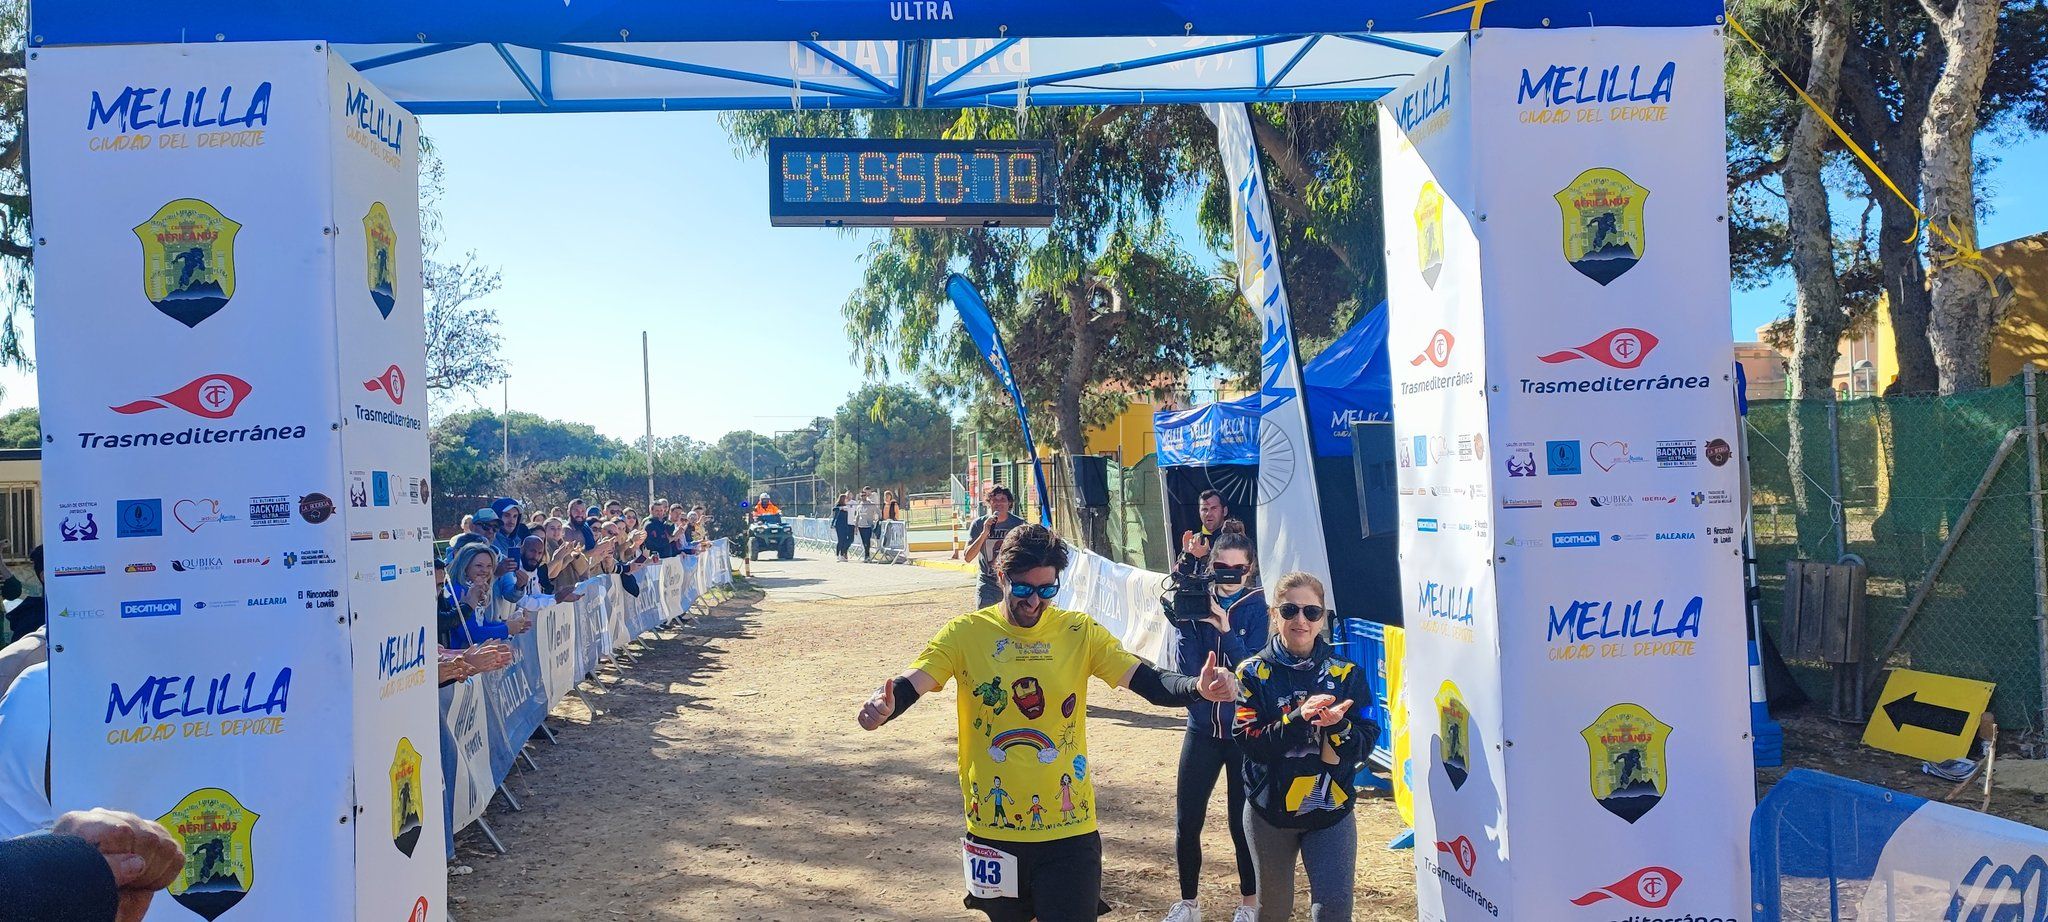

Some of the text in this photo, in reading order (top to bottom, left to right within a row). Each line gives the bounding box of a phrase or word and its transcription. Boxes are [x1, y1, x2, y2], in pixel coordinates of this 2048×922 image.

[890, 1, 953, 21] ULTRA
[1517, 61, 1676, 108] MELILLA
[87, 82, 272, 133] MELILLA
[1396, 65, 1451, 138] MELILLA
[346, 82, 402, 157] MELILLA
[1519, 105, 1670, 124] CIUDAD DEL DEPORTE
[89, 130, 266, 152] CIUDAD DEL DEPORTE
[1520, 375, 1710, 394] Trasmediterránea
[354, 404, 421, 430] Trasmediterránea
[78, 424, 306, 449] Trasmediterránea
[1656, 447, 1696, 456] BACKYARD
[250, 504, 290, 514] BACKYARD
[1599, 495, 1633, 505] QUBIKA
[1555, 535, 1597, 544] DECATHLON
[182, 558, 223, 570] QUBIKA
[306, 600, 313, 609] de
[307, 589, 338, 599] Rinconcito
[1418, 580, 1473, 626] MELILLA
[125, 603, 177, 614] DECATHLON
[1547, 596, 1703, 643] MELILLA
[379, 626, 425, 680] MELILLA
[1548, 640, 1696, 661] CIUDAD DEL DEPORTE
[105, 667, 292, 724] MELILLA
[107, 716, 285, 745] CIUDAD DEL DEPORTE
[970, 858, 1001, 884] 143
[1424, 857, 1499, 918] Trasmediterránea
